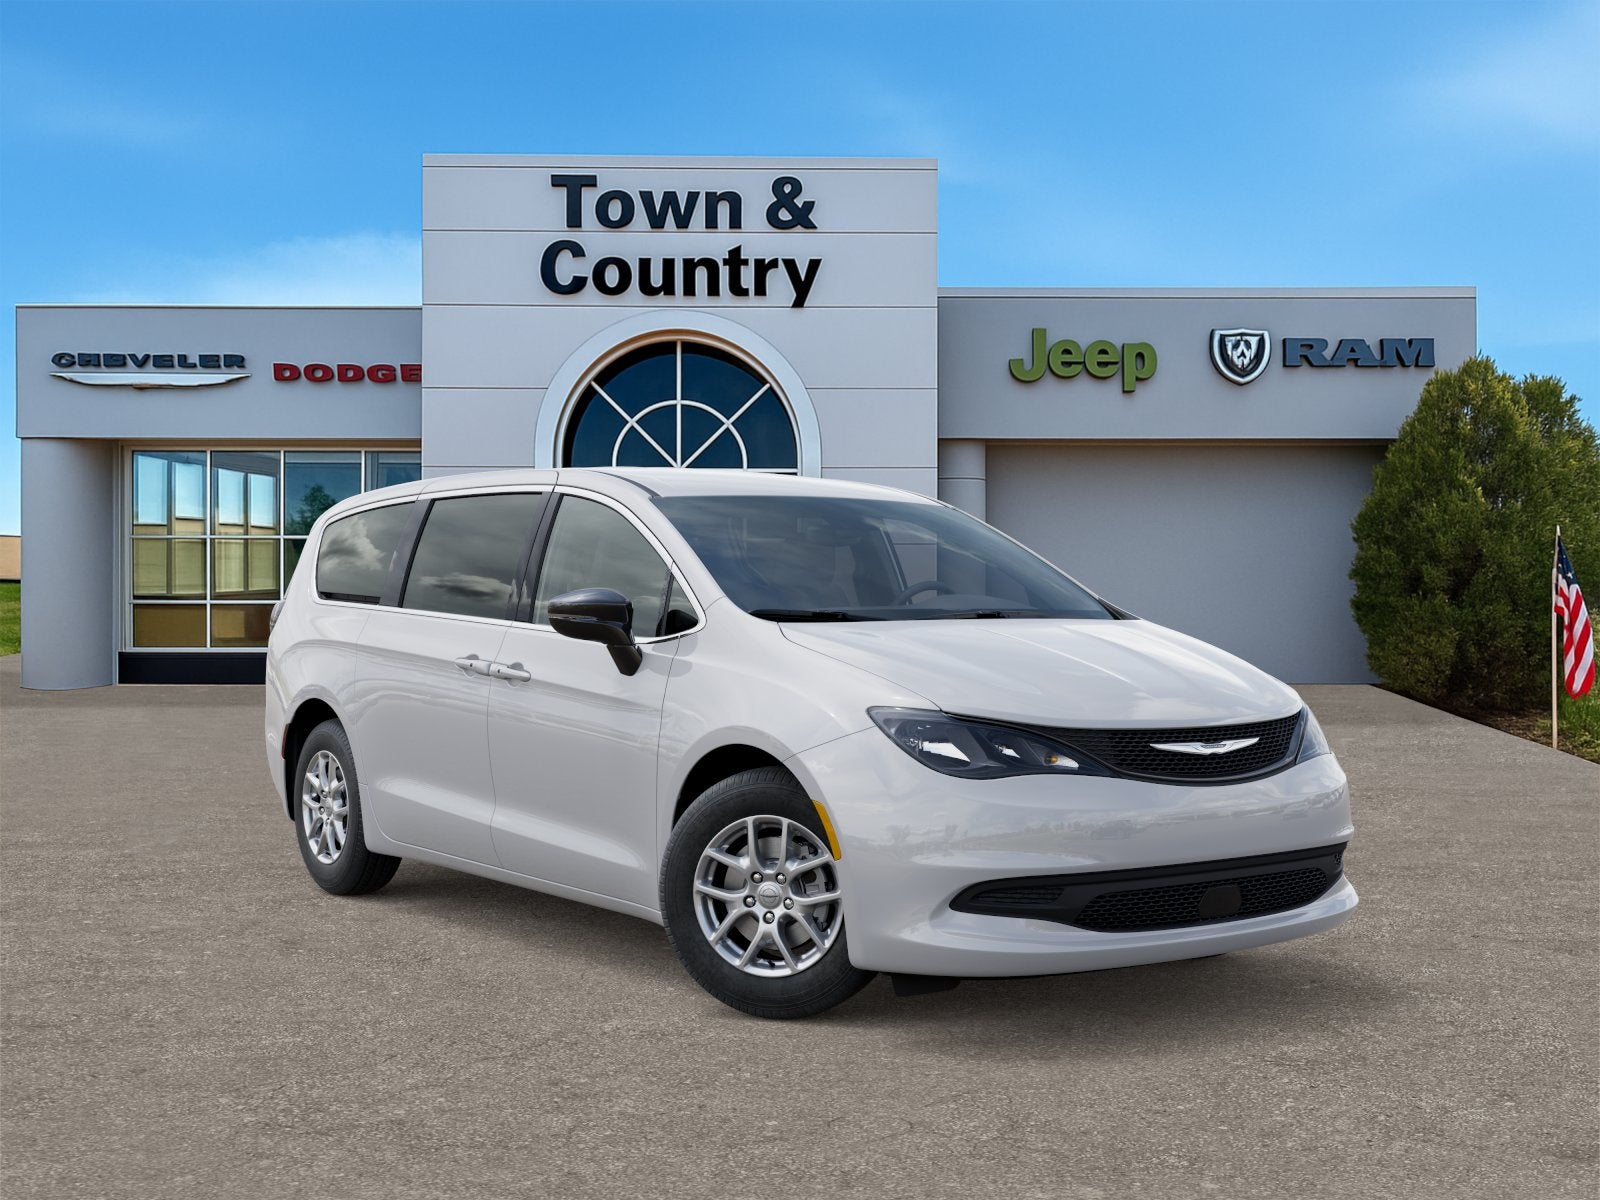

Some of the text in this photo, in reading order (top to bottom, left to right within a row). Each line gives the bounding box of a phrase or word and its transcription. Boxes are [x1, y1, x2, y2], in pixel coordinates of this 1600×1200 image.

[551, 174, 818, 230] Town &
[540, 239, 822, 308] Country
[272, 363, 422, 383] DODGE
[1009, 328, 1158, 393] Jeep
[1282, 338, 1436, 367] RAM
